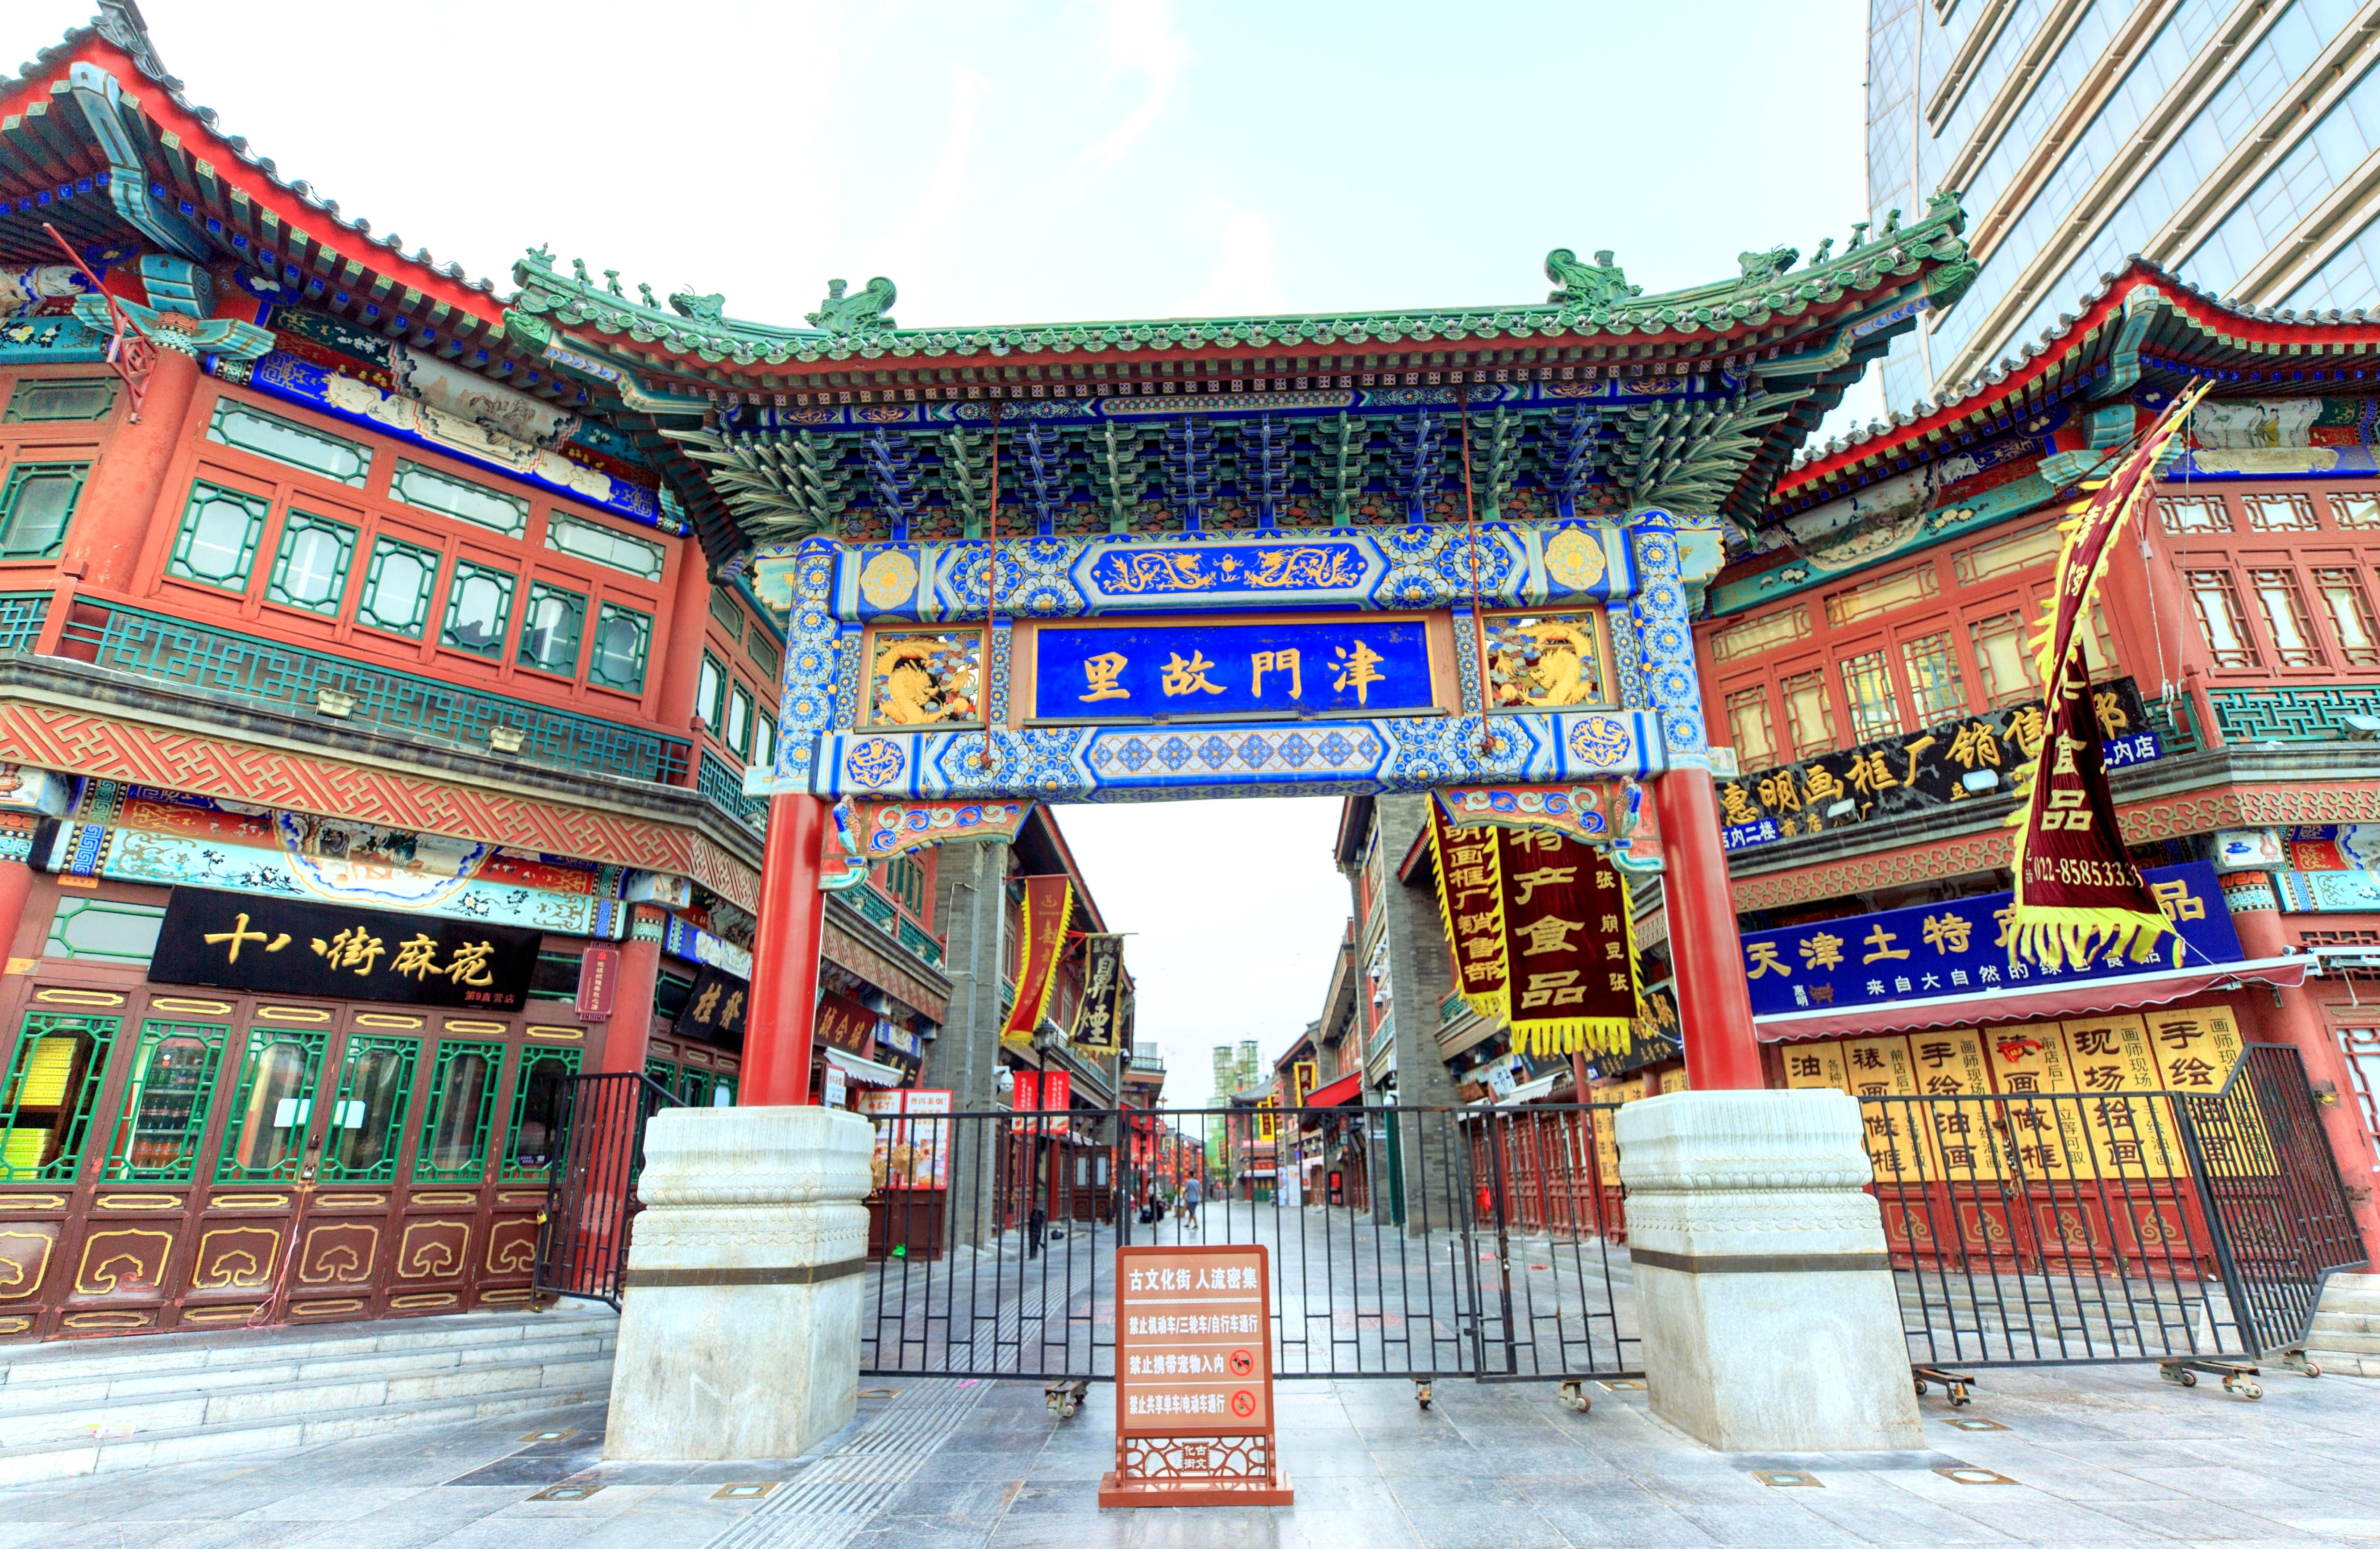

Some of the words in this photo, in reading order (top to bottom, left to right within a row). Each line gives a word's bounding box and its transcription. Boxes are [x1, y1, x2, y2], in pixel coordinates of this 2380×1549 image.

[1079, 640, 1385, 704] 津門故里
[2103, 736, 2155, 765] 内店
[1442, 816, 1501, 982] 明画框厂销售部
[204, 913, 494, 986] 十八街麻花
[1747, 879, 2205, 979] 天津土特产品
[465, 991, 515, 1004] 第9直营店
[693, 982, 746, 1030] 桂發
[1960, 1040, 1985, 1096] 画师现场
[2040, 1036, 2065, 1092] 前店后厂
[2121, 1028, 2152, 1087] 画师现场
[1129, 1268, 1191, 1291] 古文化街
[1196, 1267, 1257, 1290] 人流密集
[1129, 1314, 1258, 1335] 禁止机动车/三轮车/自行车通行
[1130, 1354, 1224, 1375] 禁止携带宠物入内
[1129, 1393, 1225, 1415] 禁止共享单车/电动车通行
